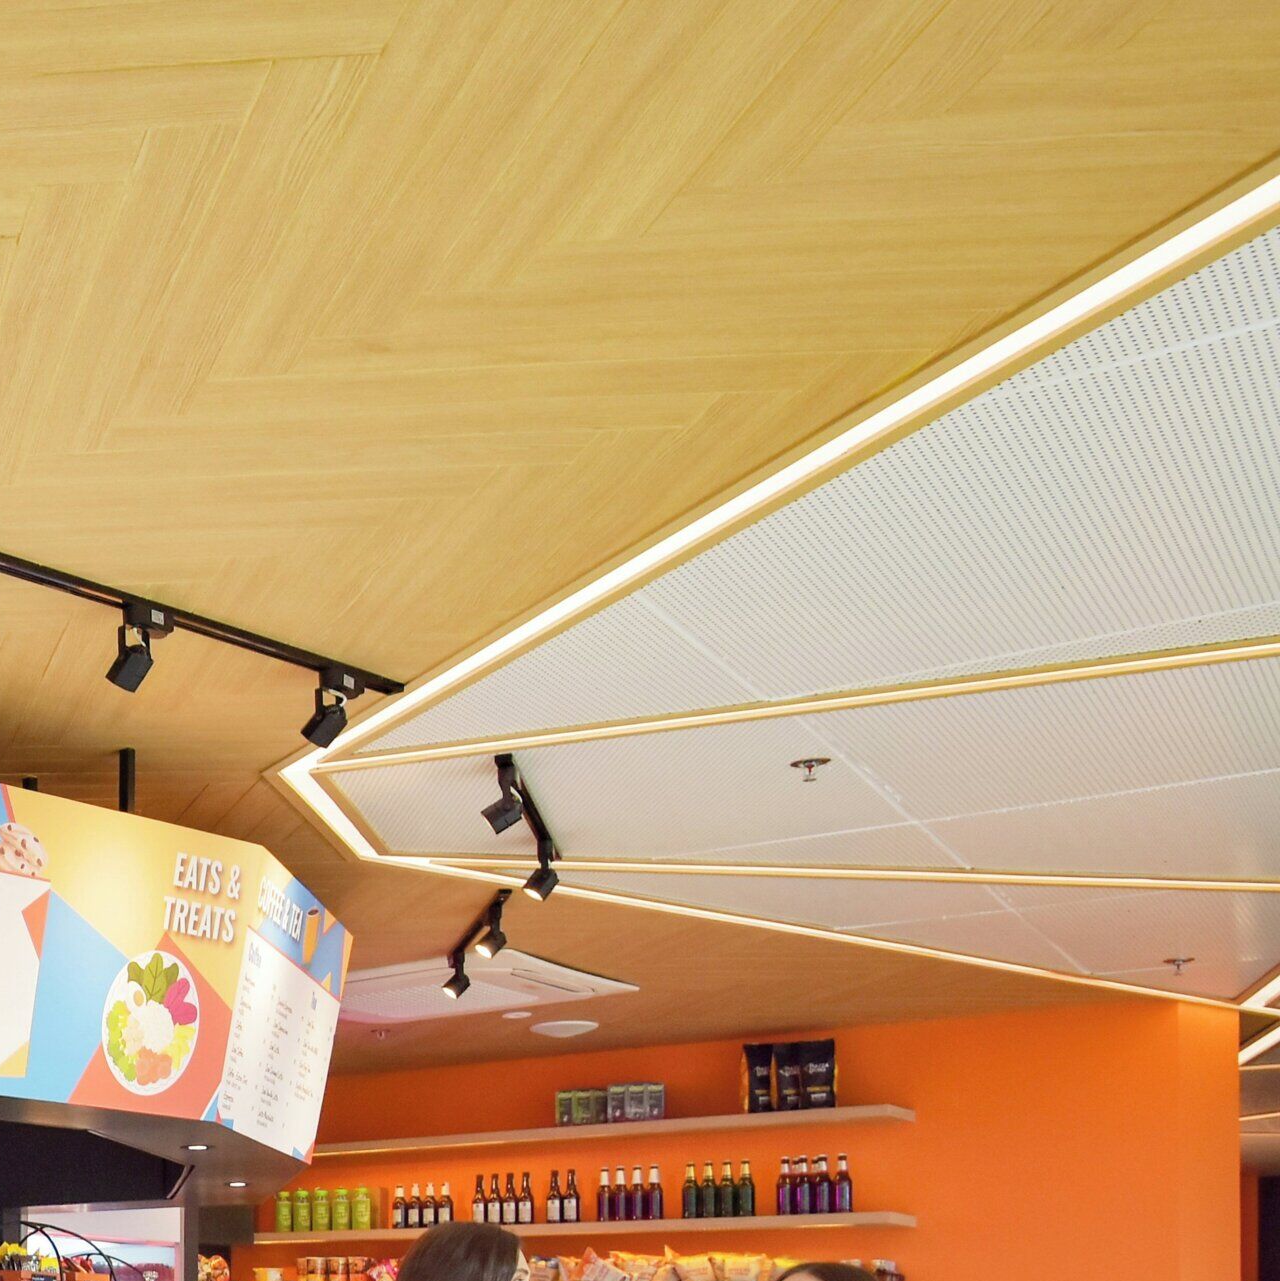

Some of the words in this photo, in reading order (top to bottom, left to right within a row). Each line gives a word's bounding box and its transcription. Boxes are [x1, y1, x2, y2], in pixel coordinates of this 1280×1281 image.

[173, 852, 224, 895] EATS
[226, 864, 240, 900] &
[163, 896, 236, 943] TREATS
[258, 875, 285, 926] COFFEE
[289, 903, 303, 942] TEA
